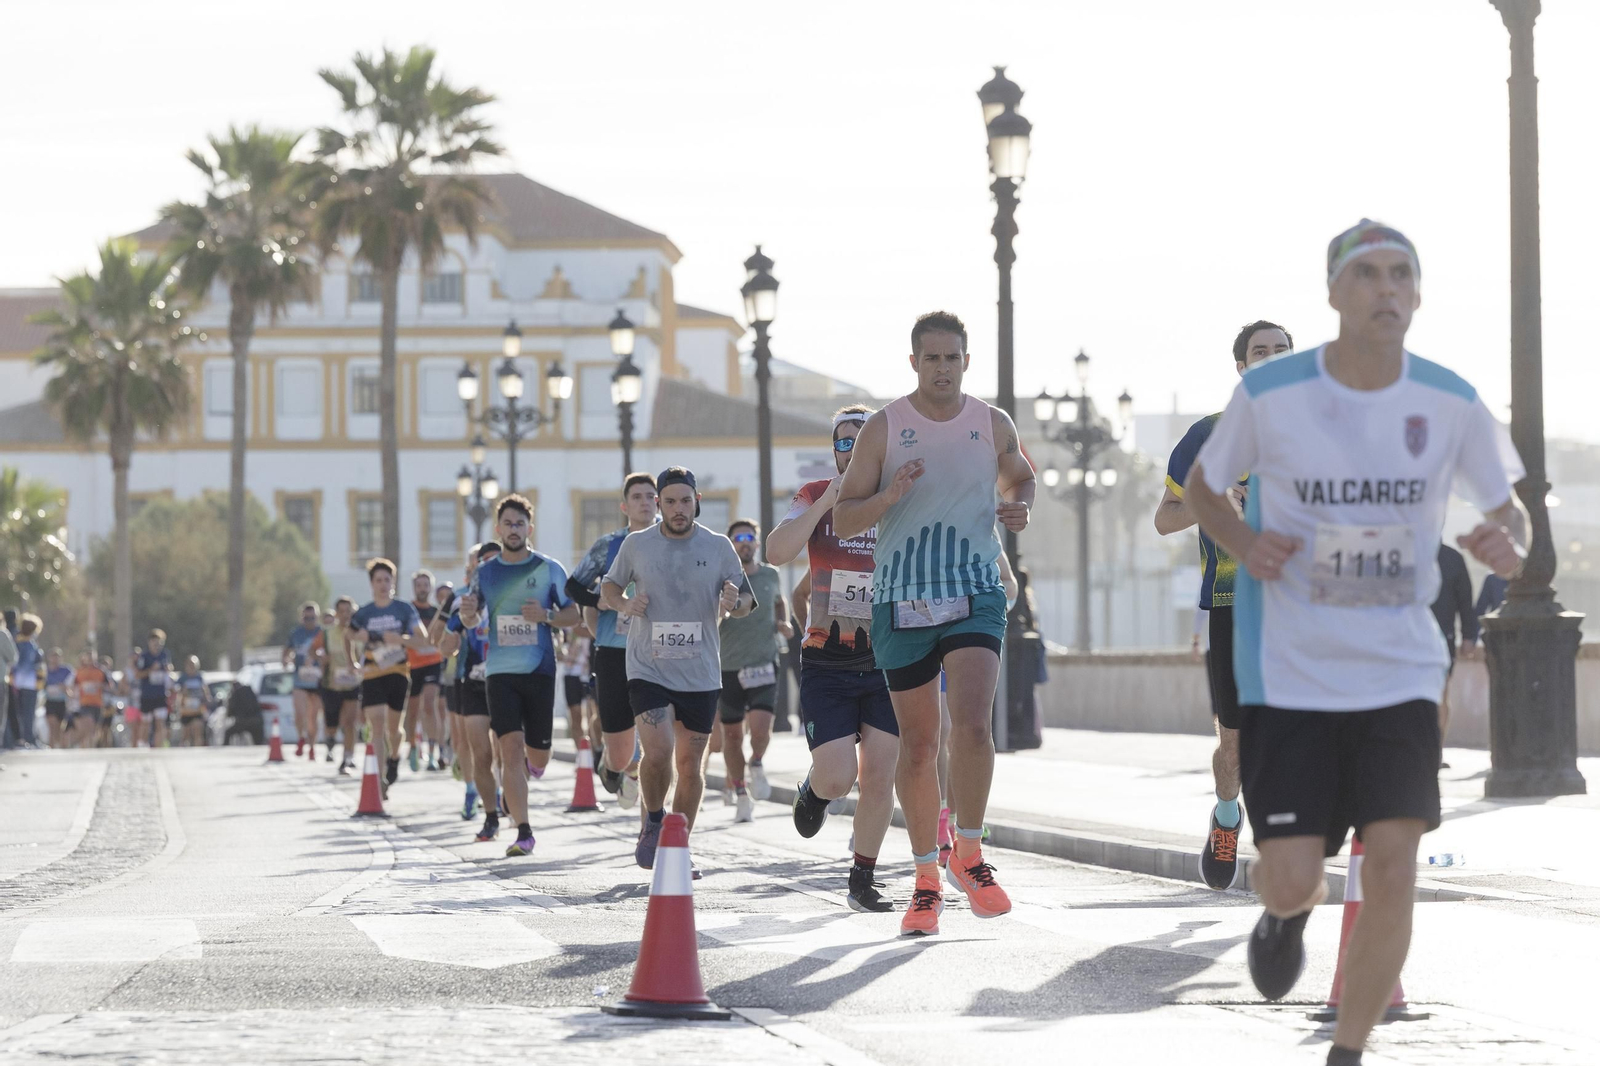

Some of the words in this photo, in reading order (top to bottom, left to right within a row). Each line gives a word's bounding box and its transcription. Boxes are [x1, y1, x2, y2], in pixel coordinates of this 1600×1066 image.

[838, 539, 866, 549] Ciudad
[1329, 549, 1402, 578] 1118
[503, 624, 532, 636] 1668
[658, 633, 695, 647] 1524
